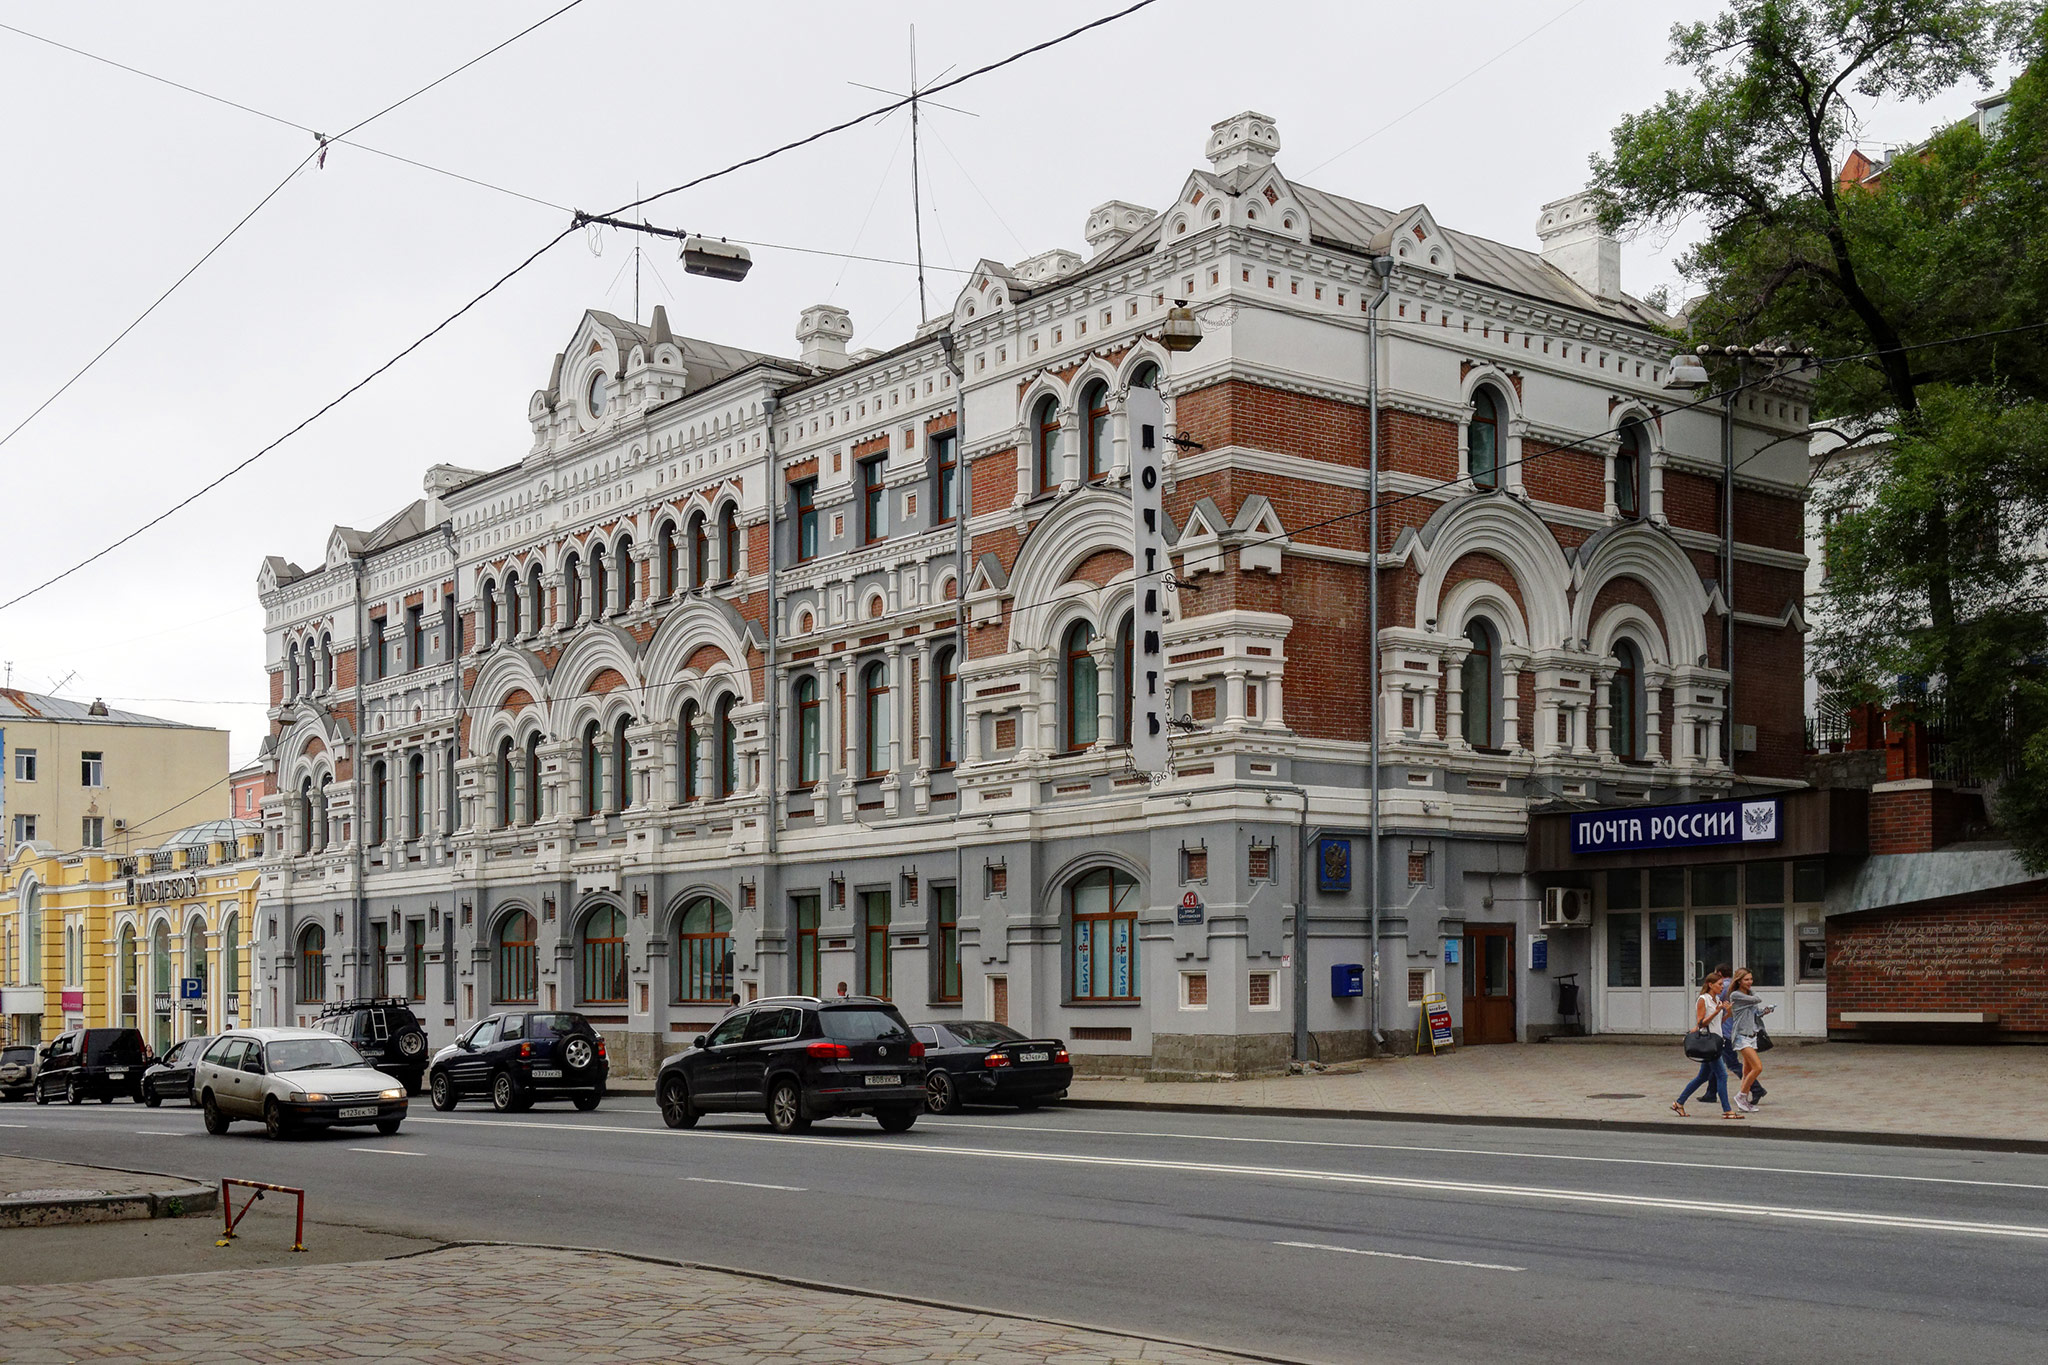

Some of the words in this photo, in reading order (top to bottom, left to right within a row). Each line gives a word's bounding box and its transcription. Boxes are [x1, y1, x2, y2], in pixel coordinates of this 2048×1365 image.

[1141, 424, 1160, 736] ПОЧТАМТЪ
[1579, 818, 1643, 845] ПОЧТА
[1651, 811, 1735, 840] РОССИИ
[1184, 894, 1195, 906] 41
[186, 980, 198, 997] P
